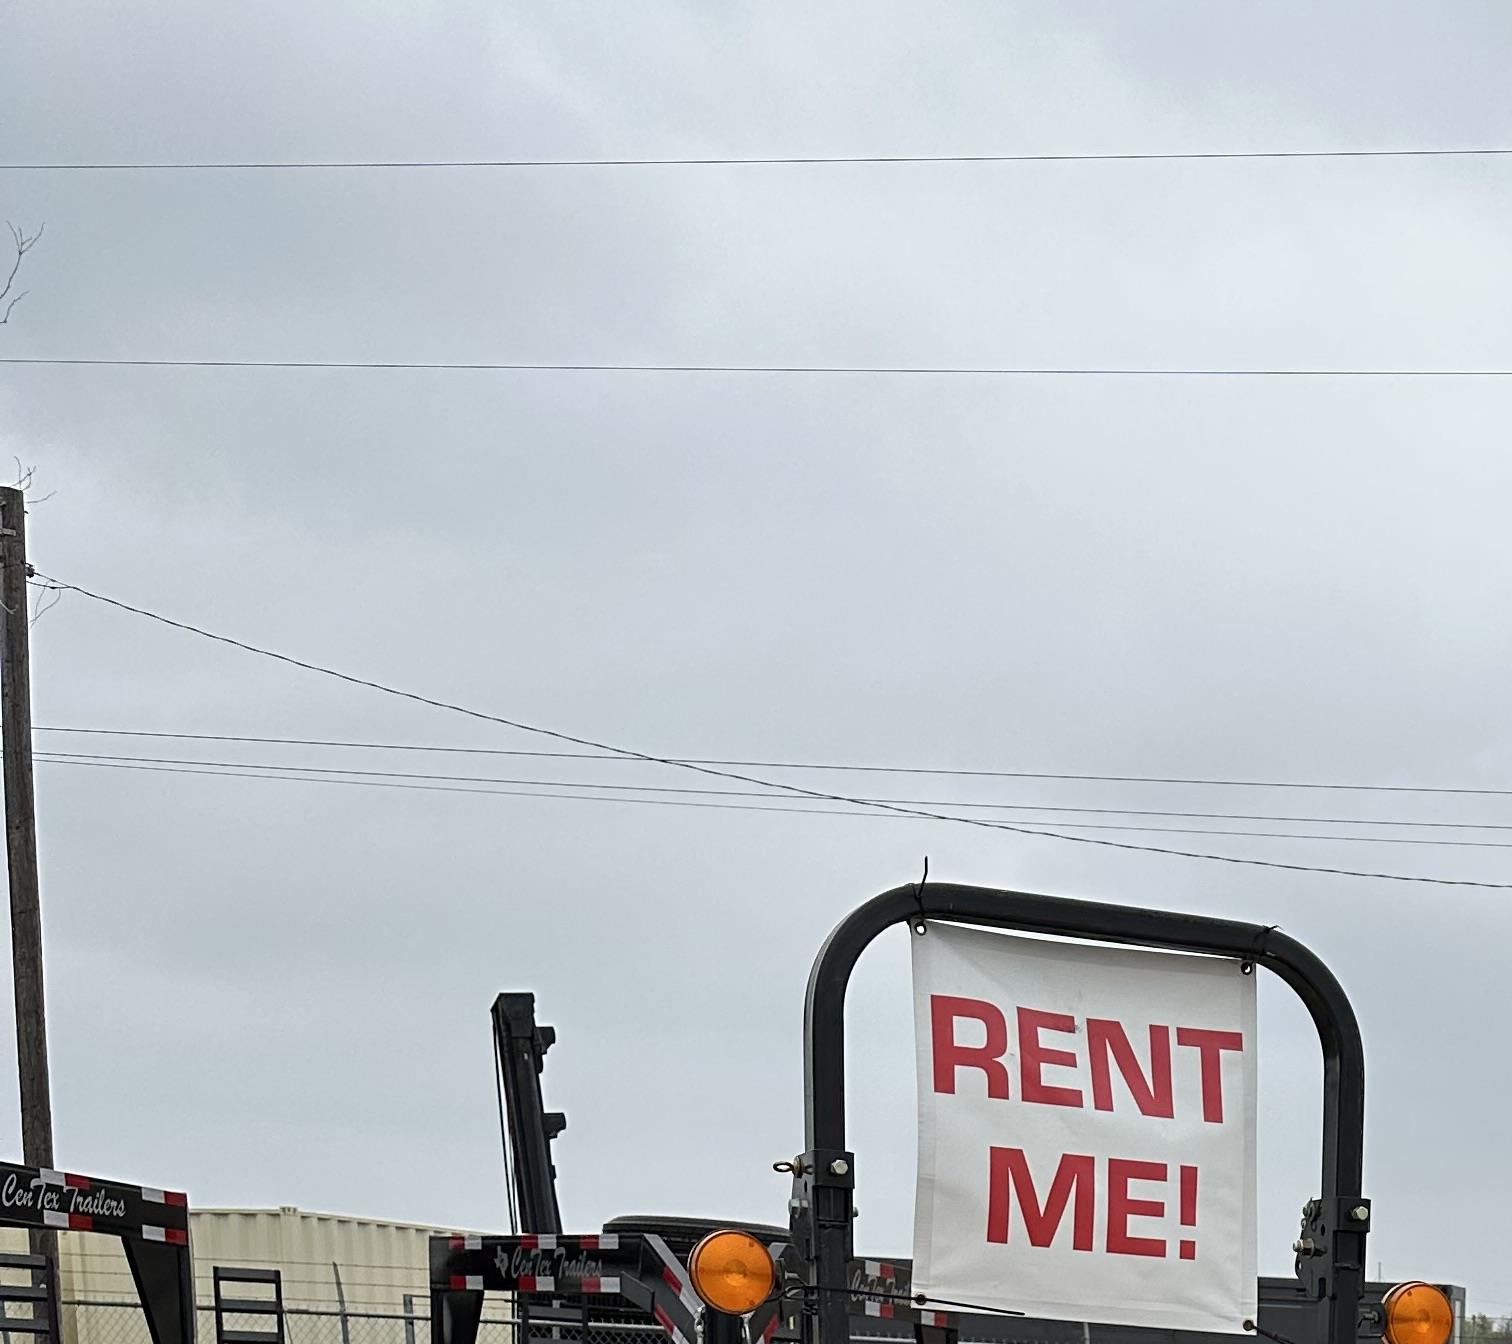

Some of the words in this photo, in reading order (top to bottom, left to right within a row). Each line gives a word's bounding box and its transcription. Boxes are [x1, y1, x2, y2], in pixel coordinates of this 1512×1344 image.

[930, 994, 1243, 1124] RENT
[2, 1174, 60, 1210] CenTex
[63, 1185, 126, 1217] Trailers
[986, 1146, 1198, 1260] ME!
[554, 1246, 602, 1279] Trailers
